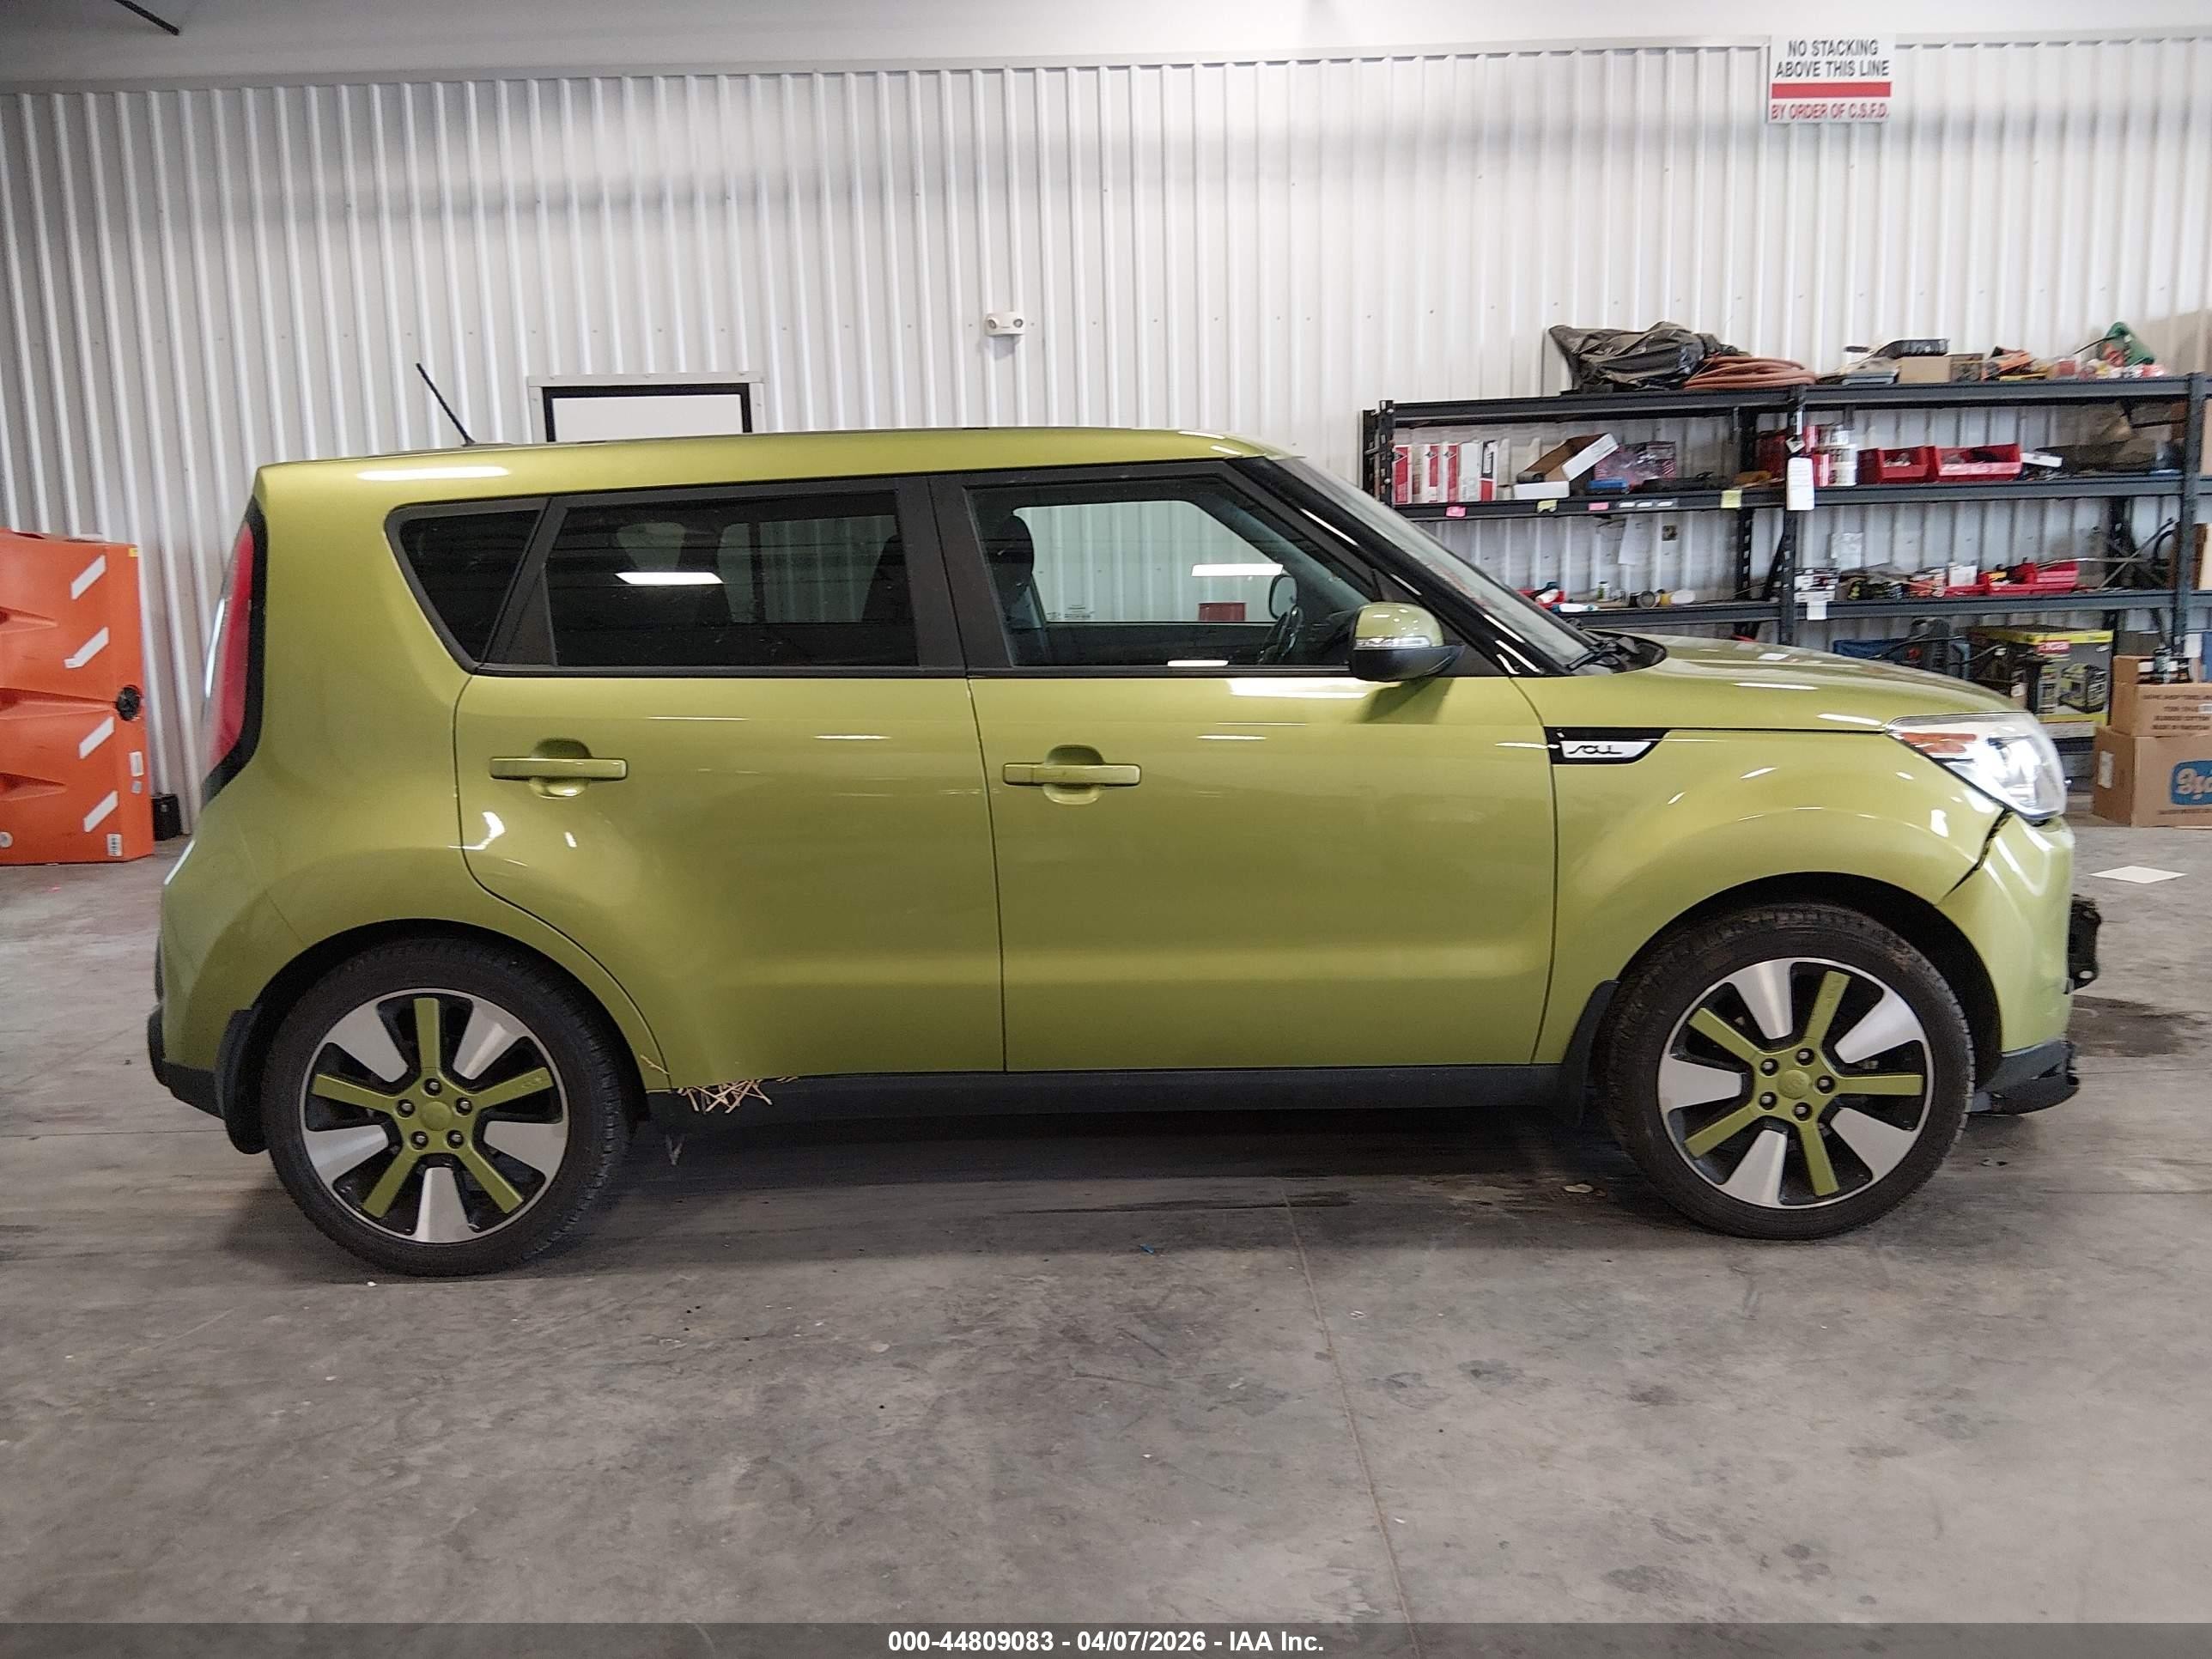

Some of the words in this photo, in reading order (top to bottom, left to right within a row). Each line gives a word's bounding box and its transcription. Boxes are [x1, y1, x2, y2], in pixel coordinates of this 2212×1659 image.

[1788, 40, 1808, 57] NO
[1811, 39, 1879, 57] STACKING
[1775, 60, 1821, 78] ABOVE
[1826, 59, 1856, 77] THIS
[1859, 59, 1890, 76] LINE
[1771, 103, 1787, 119] BY
[1790, 103, 1828, 119] ORDER
[1830, 102, 1846, 118] OF
